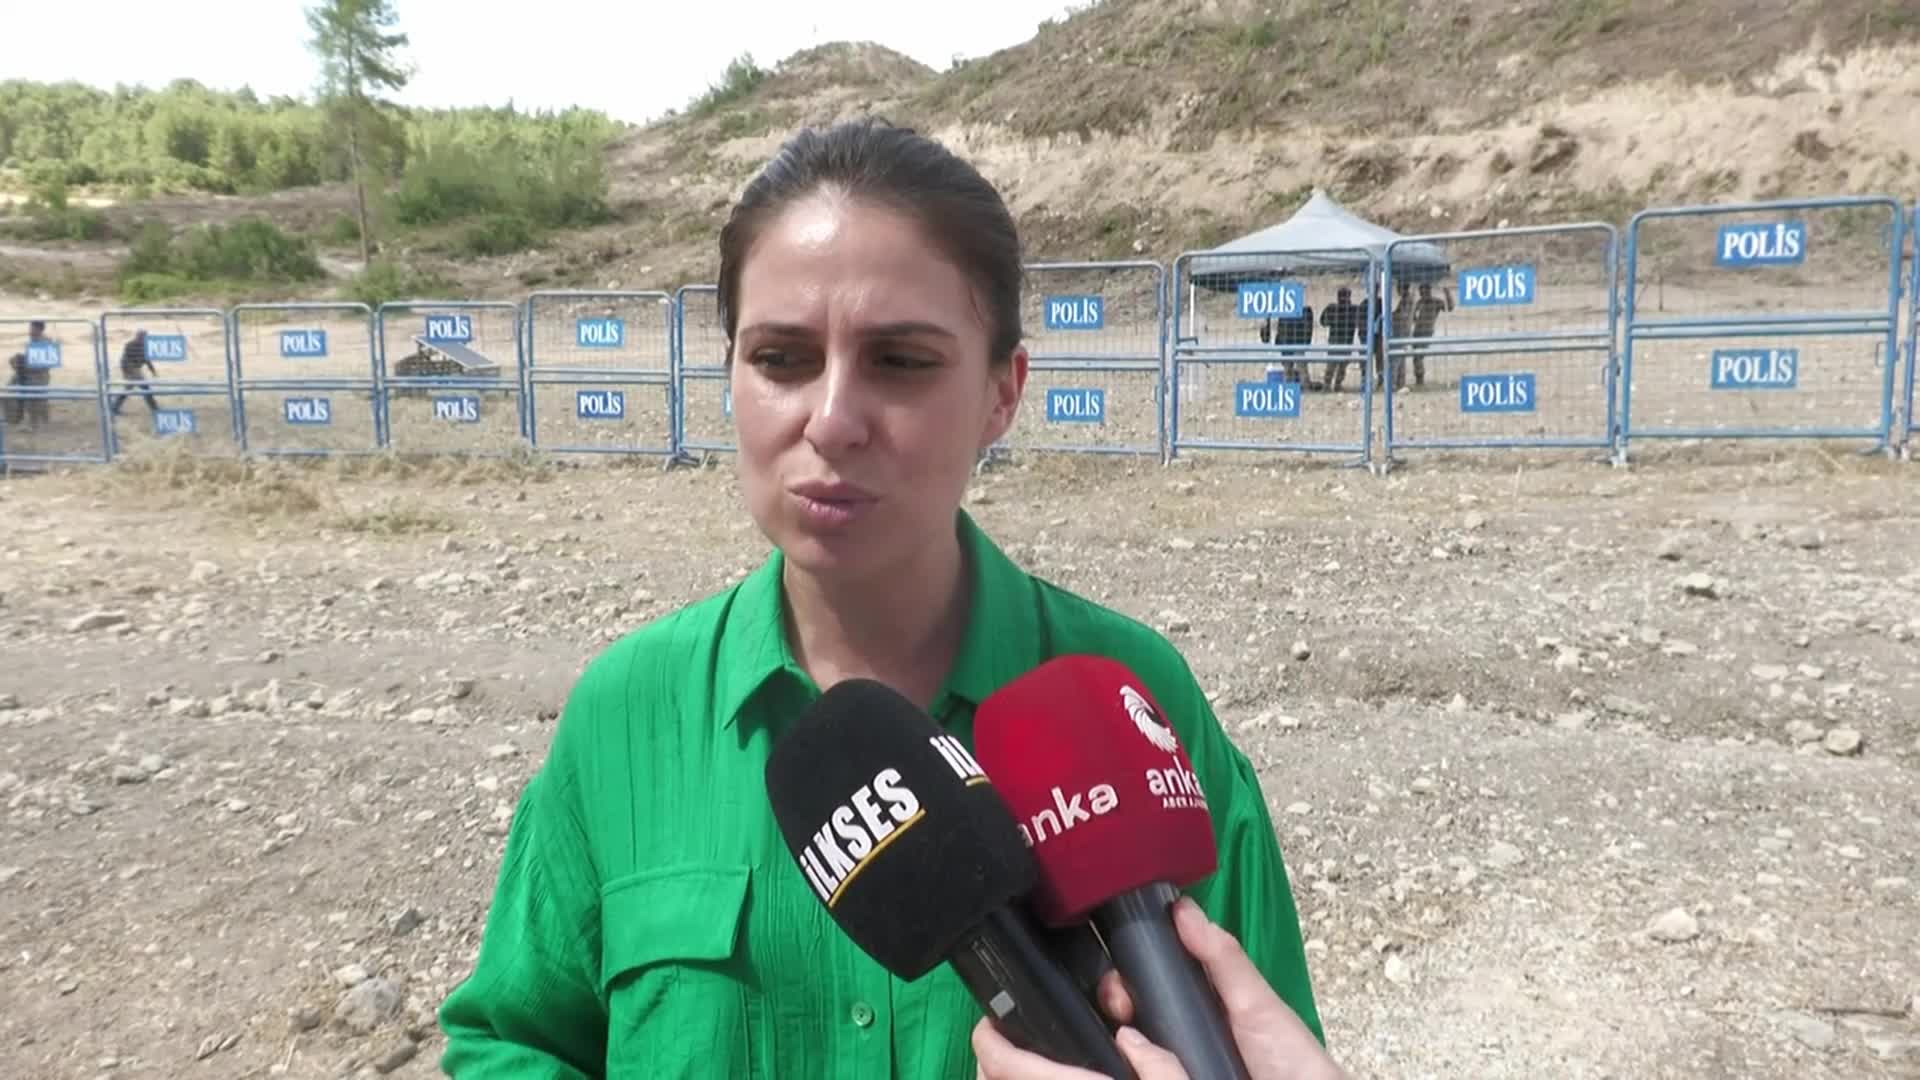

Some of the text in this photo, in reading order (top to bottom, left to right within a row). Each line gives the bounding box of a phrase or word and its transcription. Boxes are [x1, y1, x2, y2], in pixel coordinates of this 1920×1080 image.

[1722, 224, 1800, 259] POLİS
[1464, 268, 1526, 300] POLİS
[1051, 298, 1098, 324] POLİS
[1243, 285, 1296, 313] POLİS
[429, 316, 469, 338] POLİS
[580, 321, 618, 343] POLİS
[283, 330, 321, 352] POLİS
[1718, 350, 1793, 383] POLİS
[579, 392, 621, 414] POLİS
[1242, 384, 1294, 411] POLİS
[1467, 375, 1527, 406] POLİS
[287, 399, 328, 420] POLİS
[437, 398, 477, 420] POLİS
[1054, 391, 1100, 416] POLİS
